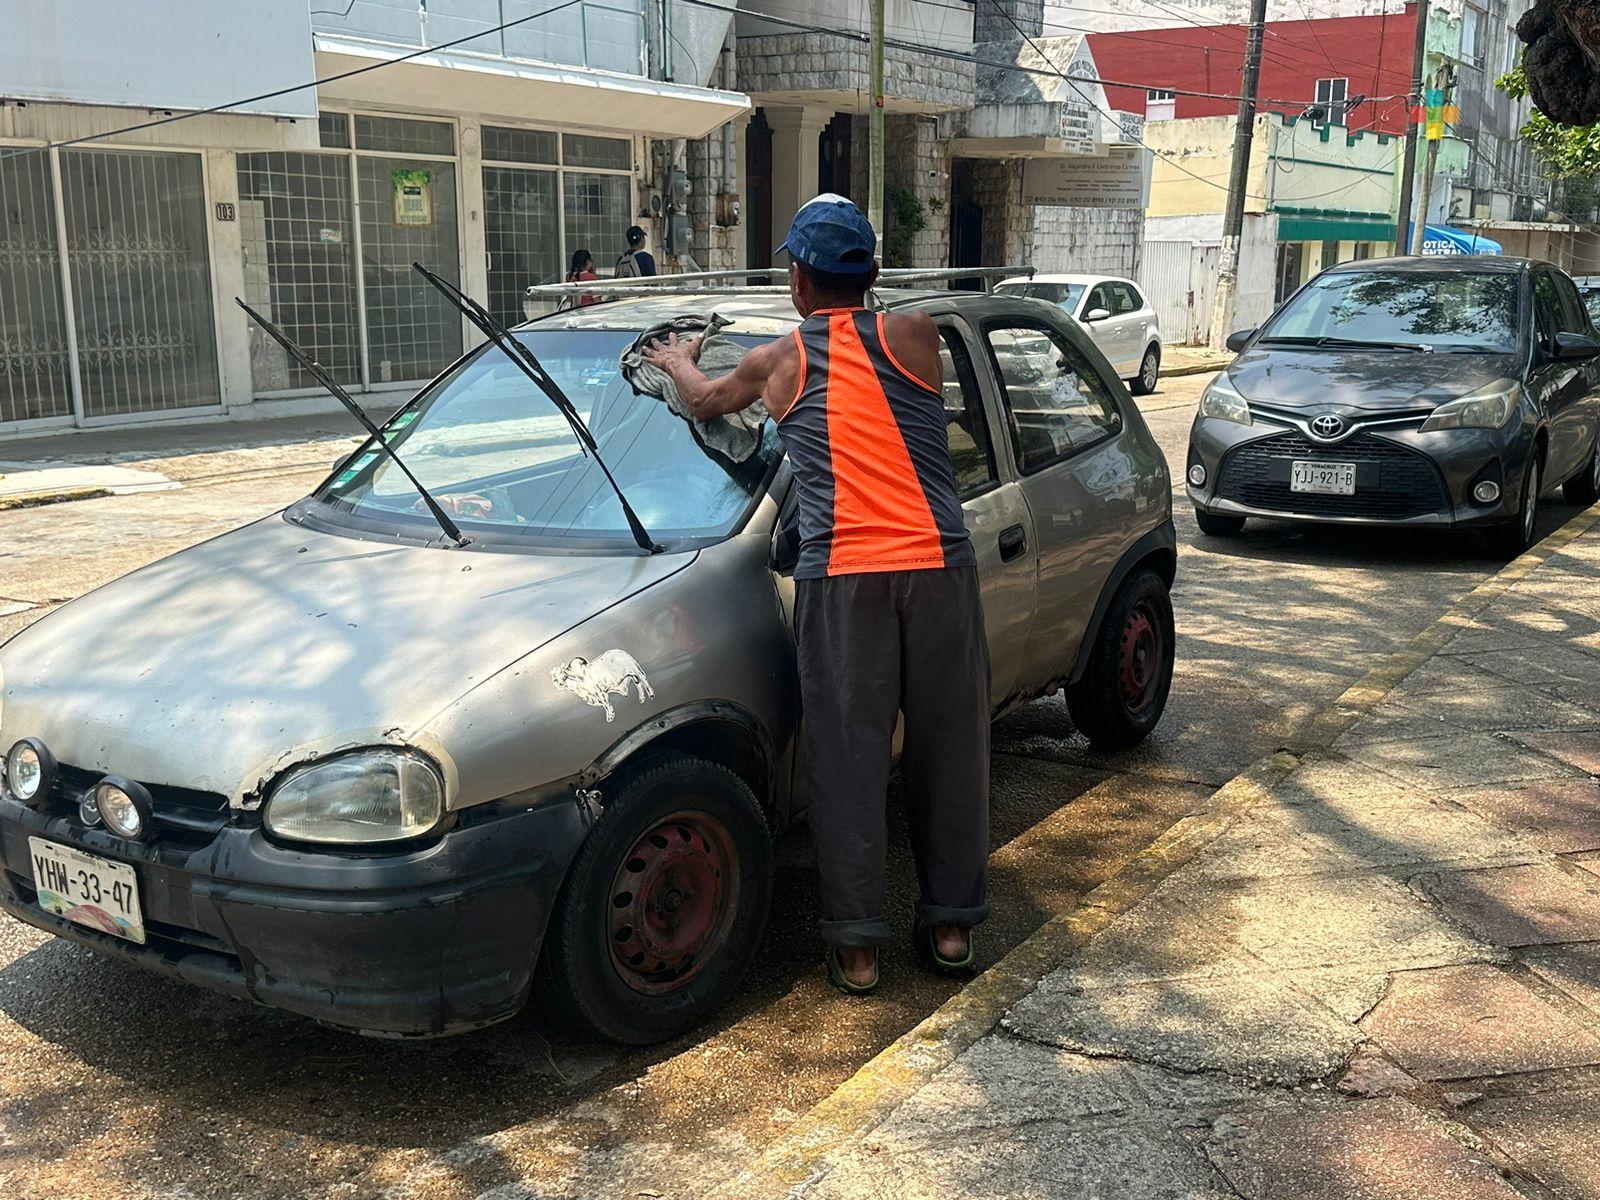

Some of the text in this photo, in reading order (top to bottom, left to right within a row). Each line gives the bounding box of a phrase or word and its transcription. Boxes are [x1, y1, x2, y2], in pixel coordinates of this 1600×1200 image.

[218, 205, 233, 218] 103
[1423, 240, 1456, 249] OTICA
[1294, 470, 1353, 486] YJJ-921-B
[34, 854, 133, 914] YHW-33-47
